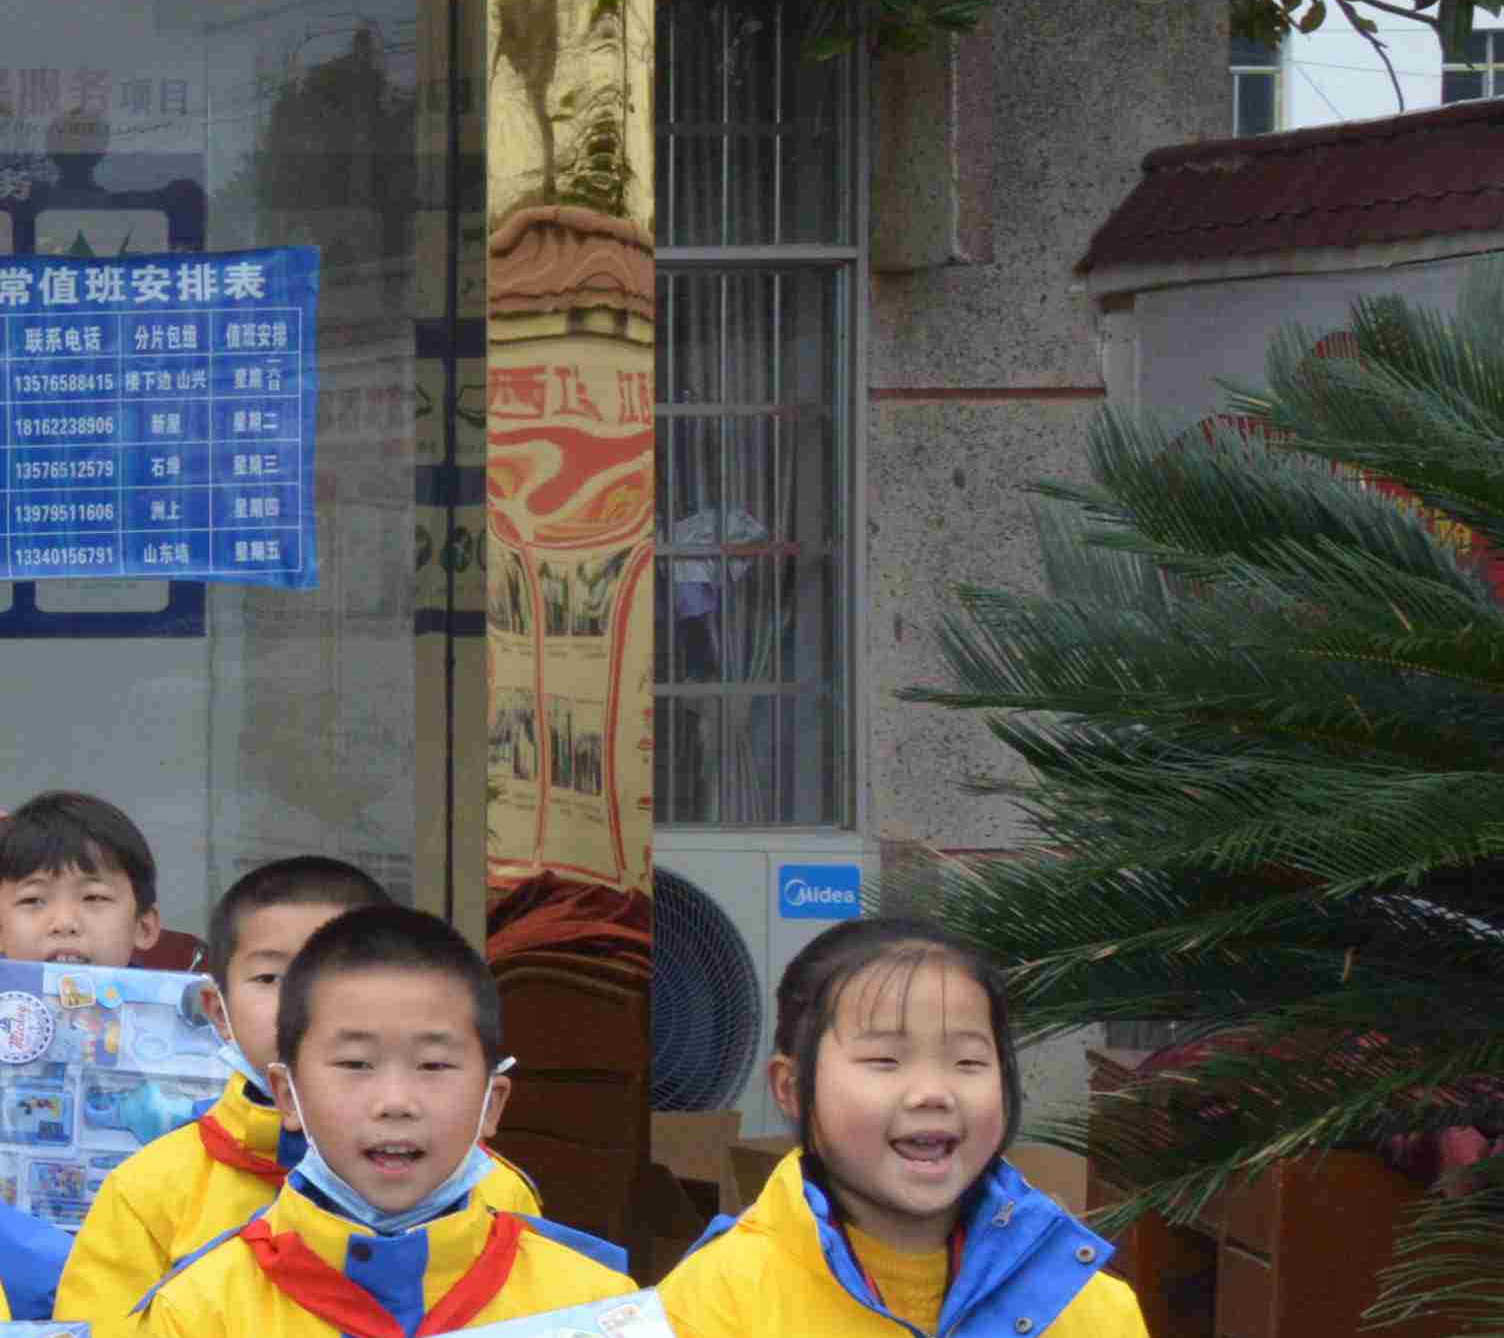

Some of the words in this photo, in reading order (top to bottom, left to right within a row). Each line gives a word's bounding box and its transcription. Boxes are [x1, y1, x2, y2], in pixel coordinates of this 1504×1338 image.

[24, 325, 103, 352] 联系电话
[134, 324, 198, 351] 分片包组
[225, 321, 288, 349] 值班安排
[15, 372, 114, 394] 13576588415
[15, 416, 114, 437] 18162238906
[233, 410, 279, 433] 星期二
[15, 459, 114, 480] 13576512579
[233, 454, 279, 477] 星期三
[15, 502, 114, 524] 13979511606
[234, 497, 281, 519] 星期四
[15, 545, 113, 566] 13340156791
[234, 540, 281, 563] 星期五
[792, 882, 855, 904] Midea
